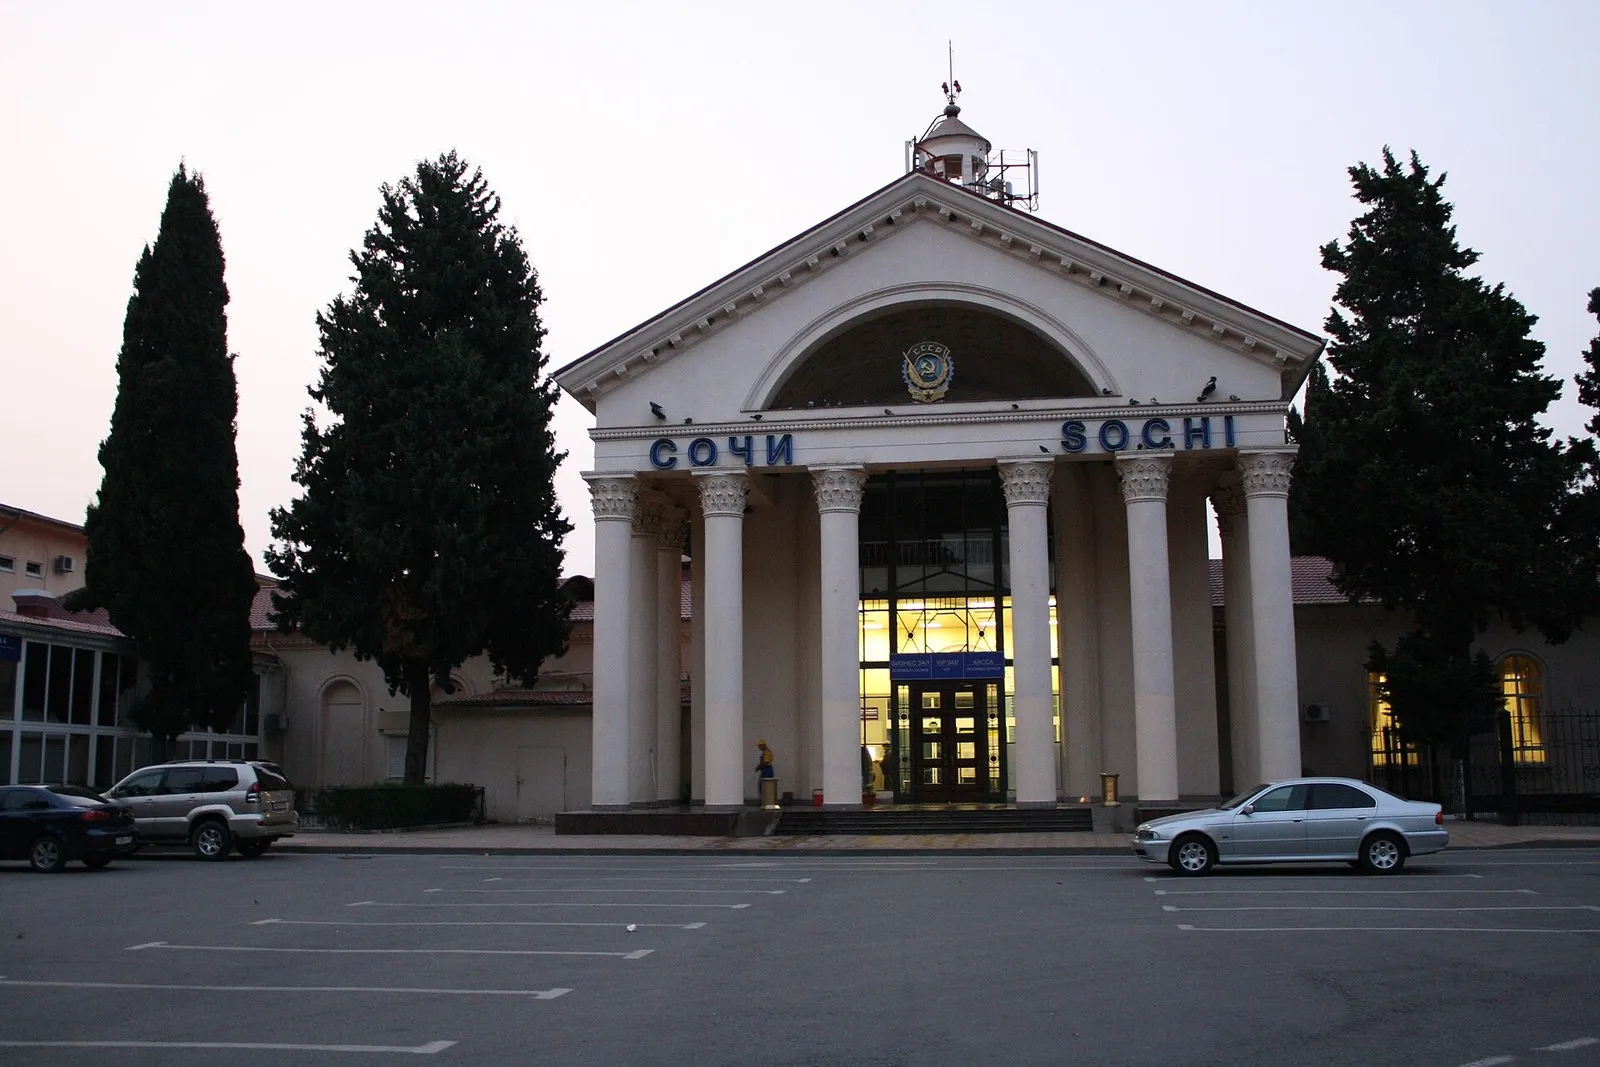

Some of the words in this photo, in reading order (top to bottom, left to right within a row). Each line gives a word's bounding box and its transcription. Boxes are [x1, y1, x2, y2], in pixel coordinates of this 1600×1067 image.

[913, 344, 942, 355] СССР
[1061, 415, 1235, 452] SOCHI
[650, 434, 793, 469] СОЧИ
